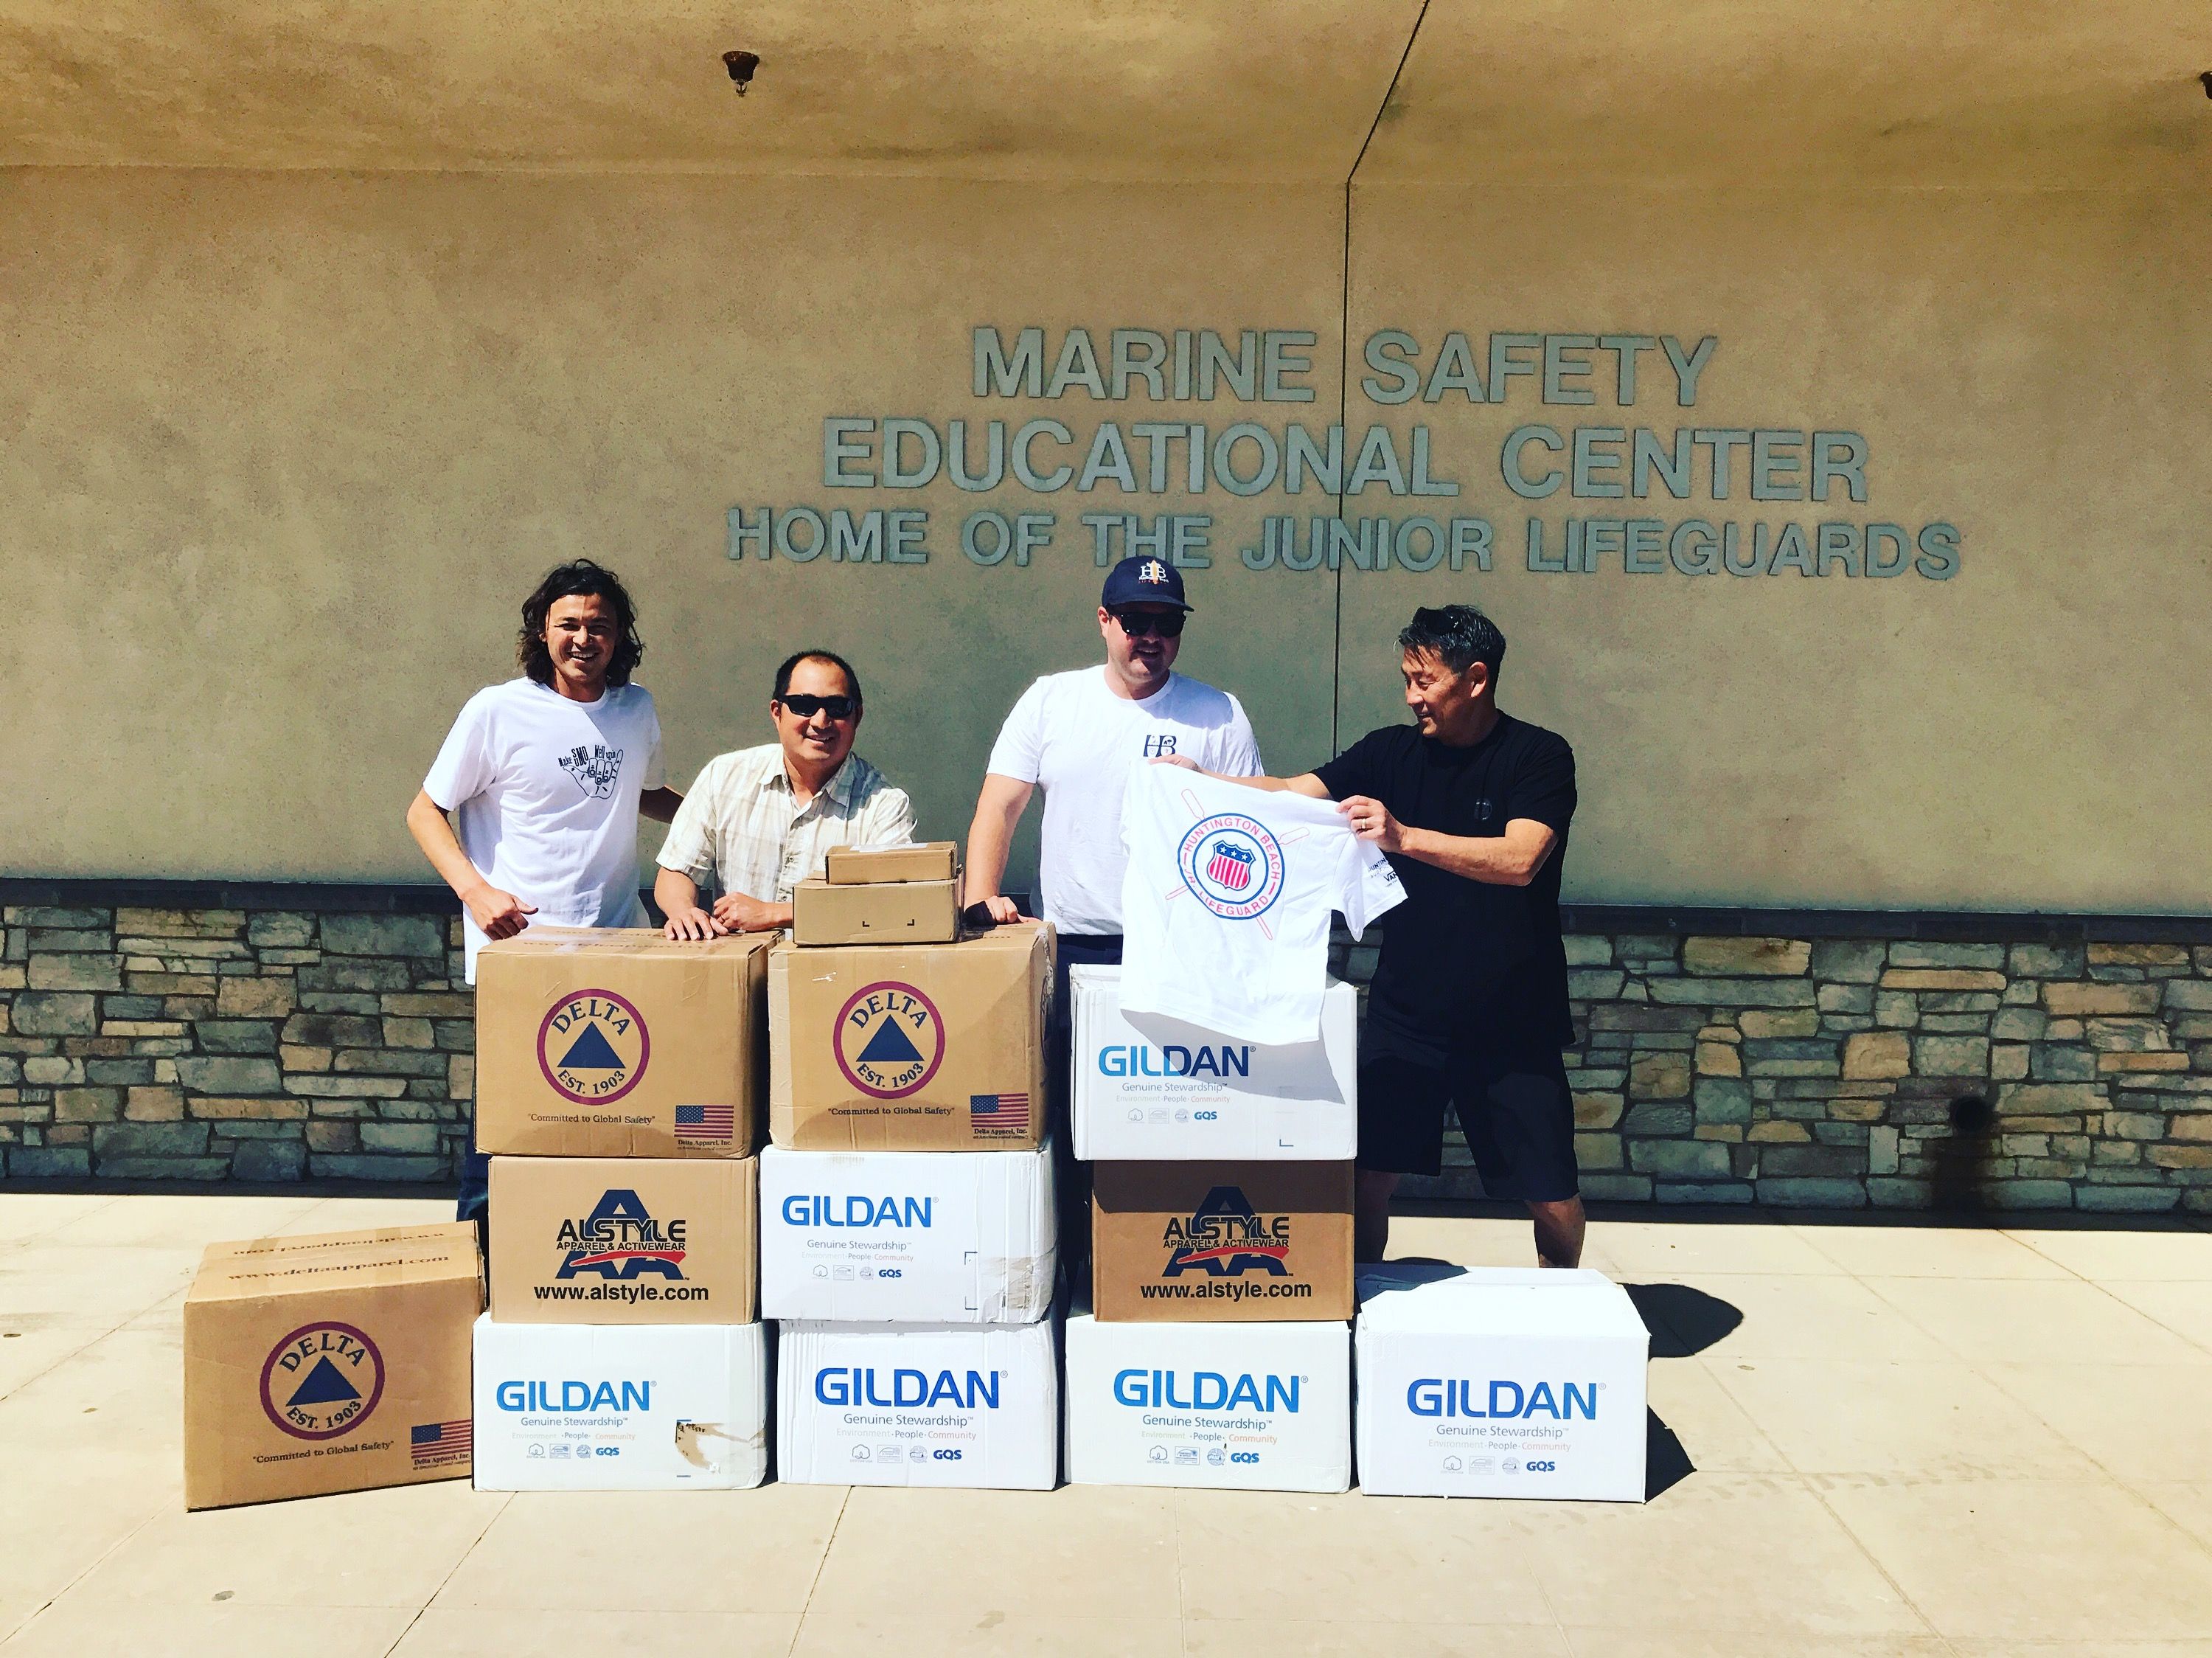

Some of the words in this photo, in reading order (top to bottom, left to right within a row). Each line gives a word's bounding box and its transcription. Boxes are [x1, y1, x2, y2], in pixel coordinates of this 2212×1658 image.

[973, 327, 1315, 403] MARINE
[1361, 330, 1717, 407] SAFETY
[823, 417, 1459, 496] EDUCATIONAL
[1501, 426, 1868, 502] CENTER
[728, 507, 928, 564] HOME
[962, 512, 1054, 566] OF
[1082, 515, 1211, 568] THE
[1242, 517, 1493, 572] JUNIOR
[1528, 519, 1961, 580] LIFEGUARDS
[1184, 817, 1260, 852] HUNTINGTON
[1260, 834, 1281, 880] BEACH
[1199, 895, 1269, 916] LIFEGUARD
[849, 992, 928, 1029] DELTA
[552, 999, 630, 1036] DELTA
[557, 1069, 586, 1095] EST.
[593, 1070, 626, 1095] 1903
[857, 1063, 886, 1088] EST.
[892, 1063, 925, 1088] 1903
[1121, 1083, 1162, 1092] Genuine
[894, 1107, 922, 1115] Global
[1194, 1111, 1217, 1121] GQS
[582, 1114, 591, 1123] to
[593, 1114, 622, 1123] Global
[556, 1219, 686, 1242] ALSTYLE
[1163, 1216, 1290, 1240] ALSTYLE
[556, 1242, 605, 1251] APPAREL
[608, 1242, 615, 1251] &
[617, 1242, 685, 1251] ACTIVEWEAR
[807, 1239, 847, 1249] Genuine
[1163, 1239, 1211, 1248] APPAREL
[1214, 1239, 1220, 1248] &
[1222, 1239, 1290, 1248] ACTIVEWEAR
[879, 1269, 902, 1278] GQS
[534, 1284, 709, 1304] www.alstyle.com
[1141, 1281, 1312, 1302] www.alstyle.com
[279, 1333, 366, 1373] DELTA
[286, 1406, 319, 1429] EST.
[325, 1401, 362, 1429] 1903
[521, 1417, 562, 1426] Genuine
[844, 1414, 893, 1425] Genuine
[1142, 1415, 1192, 1427] Genuine
[1436, 1425, 1486, 1436] Genuine
[313, 1449, 324, 1457] to
[327, 1443, 358, 1456] Global
[596, 1447, 619, 1456] GQS
[933, 1449, 962, 1460] GQS
[1231, 1452, 1259, 1464] GQS
[1526, 1461, 1555, 1473] GQS
